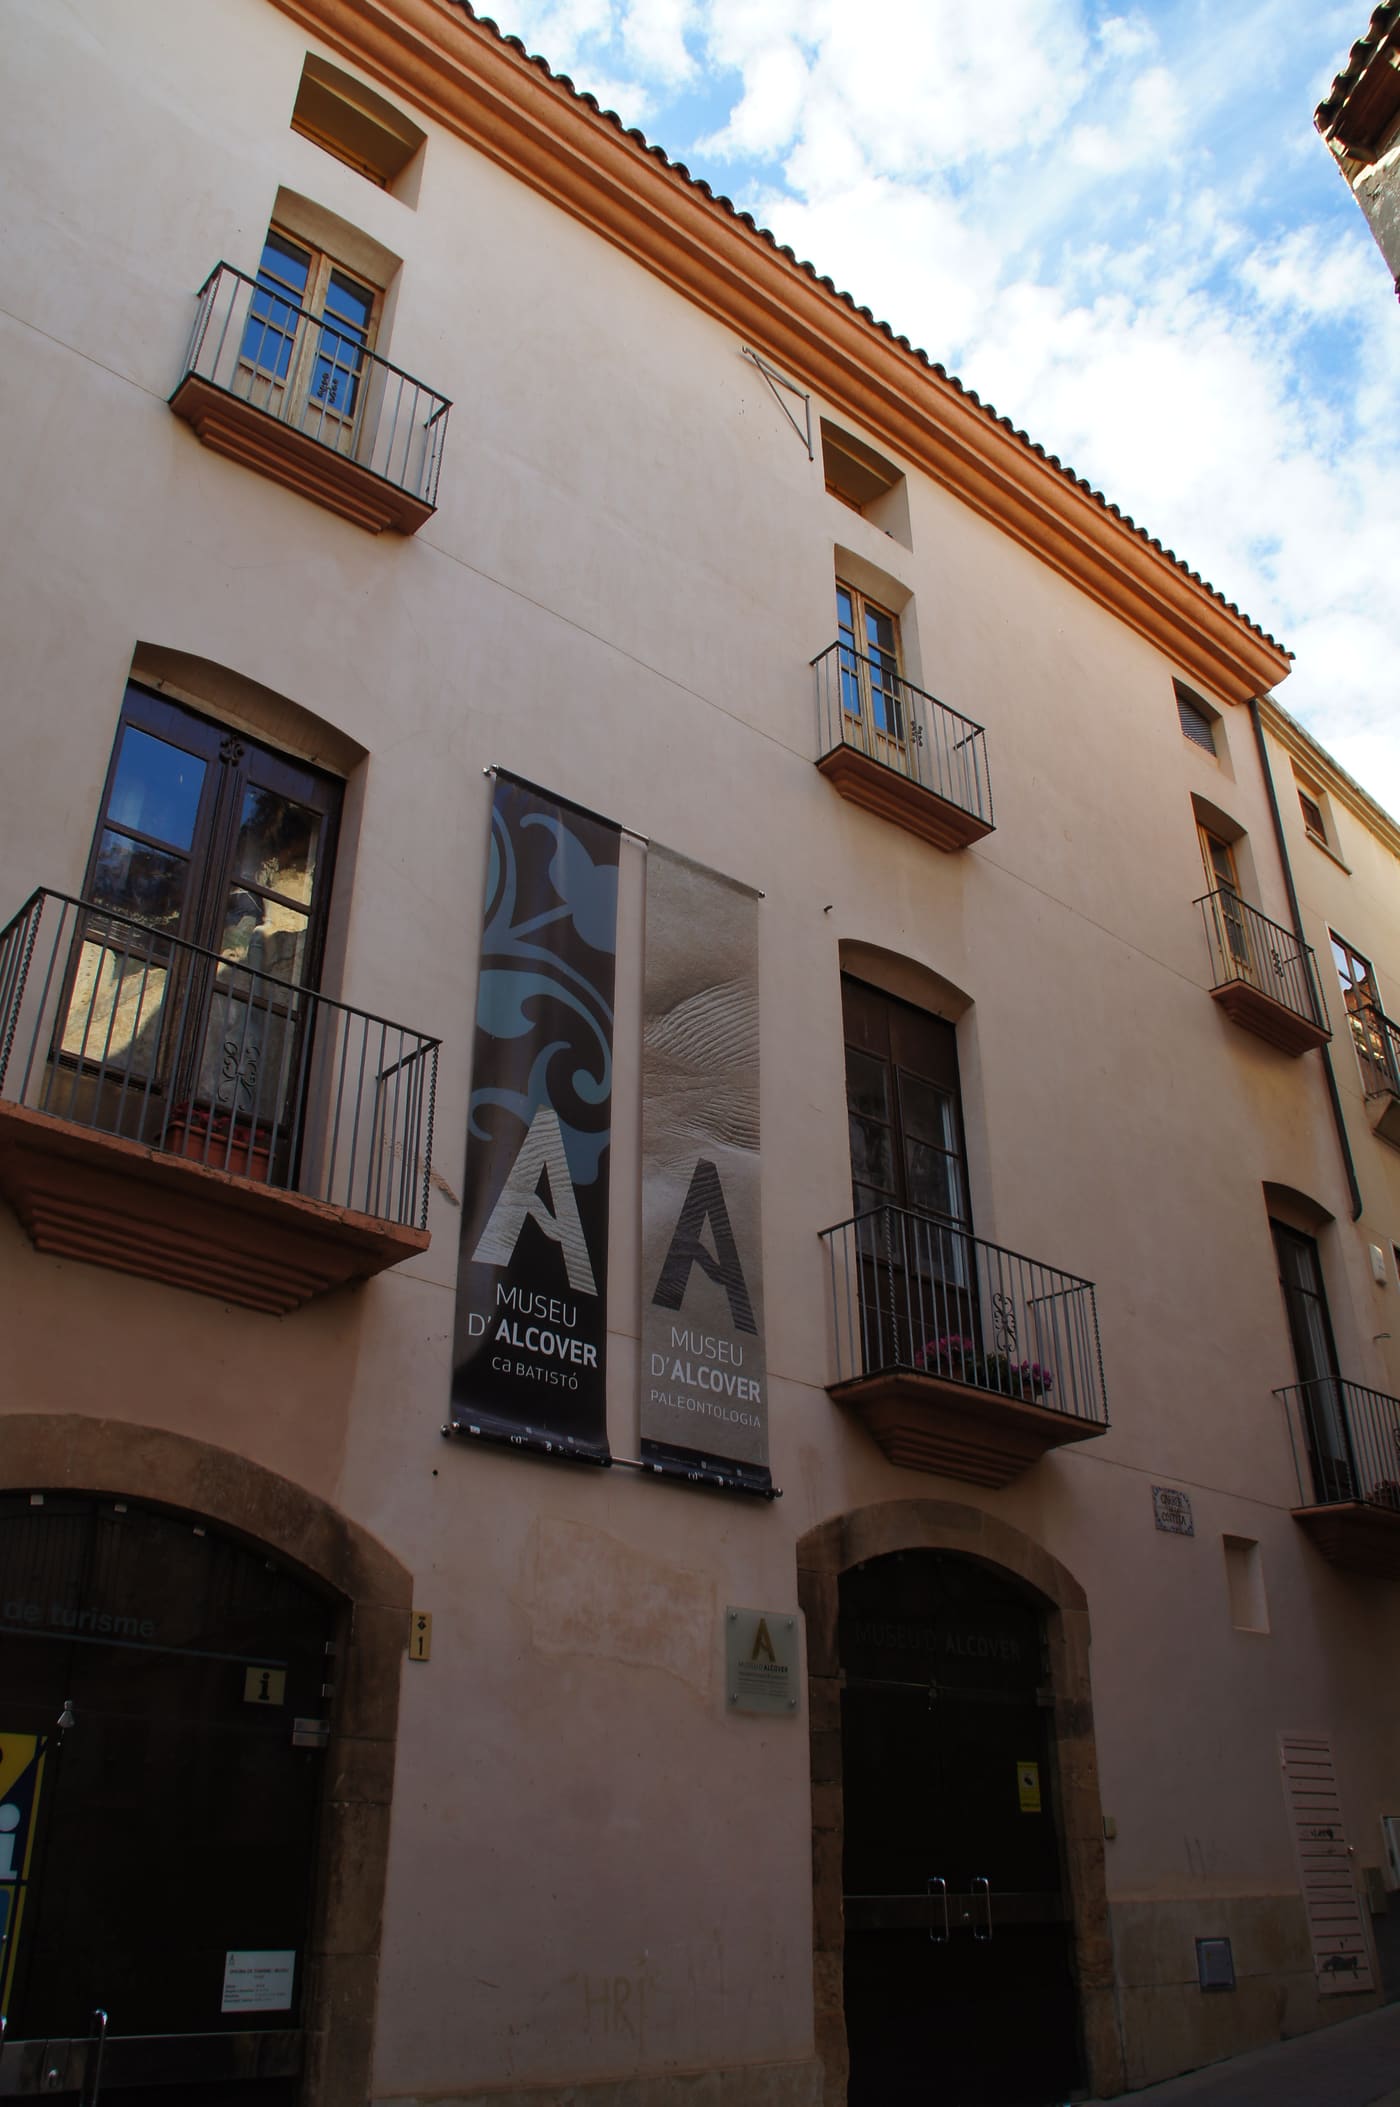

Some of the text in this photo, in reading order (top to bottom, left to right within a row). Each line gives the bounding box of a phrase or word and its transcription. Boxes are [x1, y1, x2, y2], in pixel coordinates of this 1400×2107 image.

[496, 1282, 577, 1328] MUSEU
[671, 1326, 743, 1367] MUSEU
[515, 1361, 579, 1391] BATISTÓ
[651, 1353, 761, 1404] D'ALCOVER
[650, 1389, 761, 1428] PALEONTOLOGIA
[4, 1600, 154, 1638] de turisme
